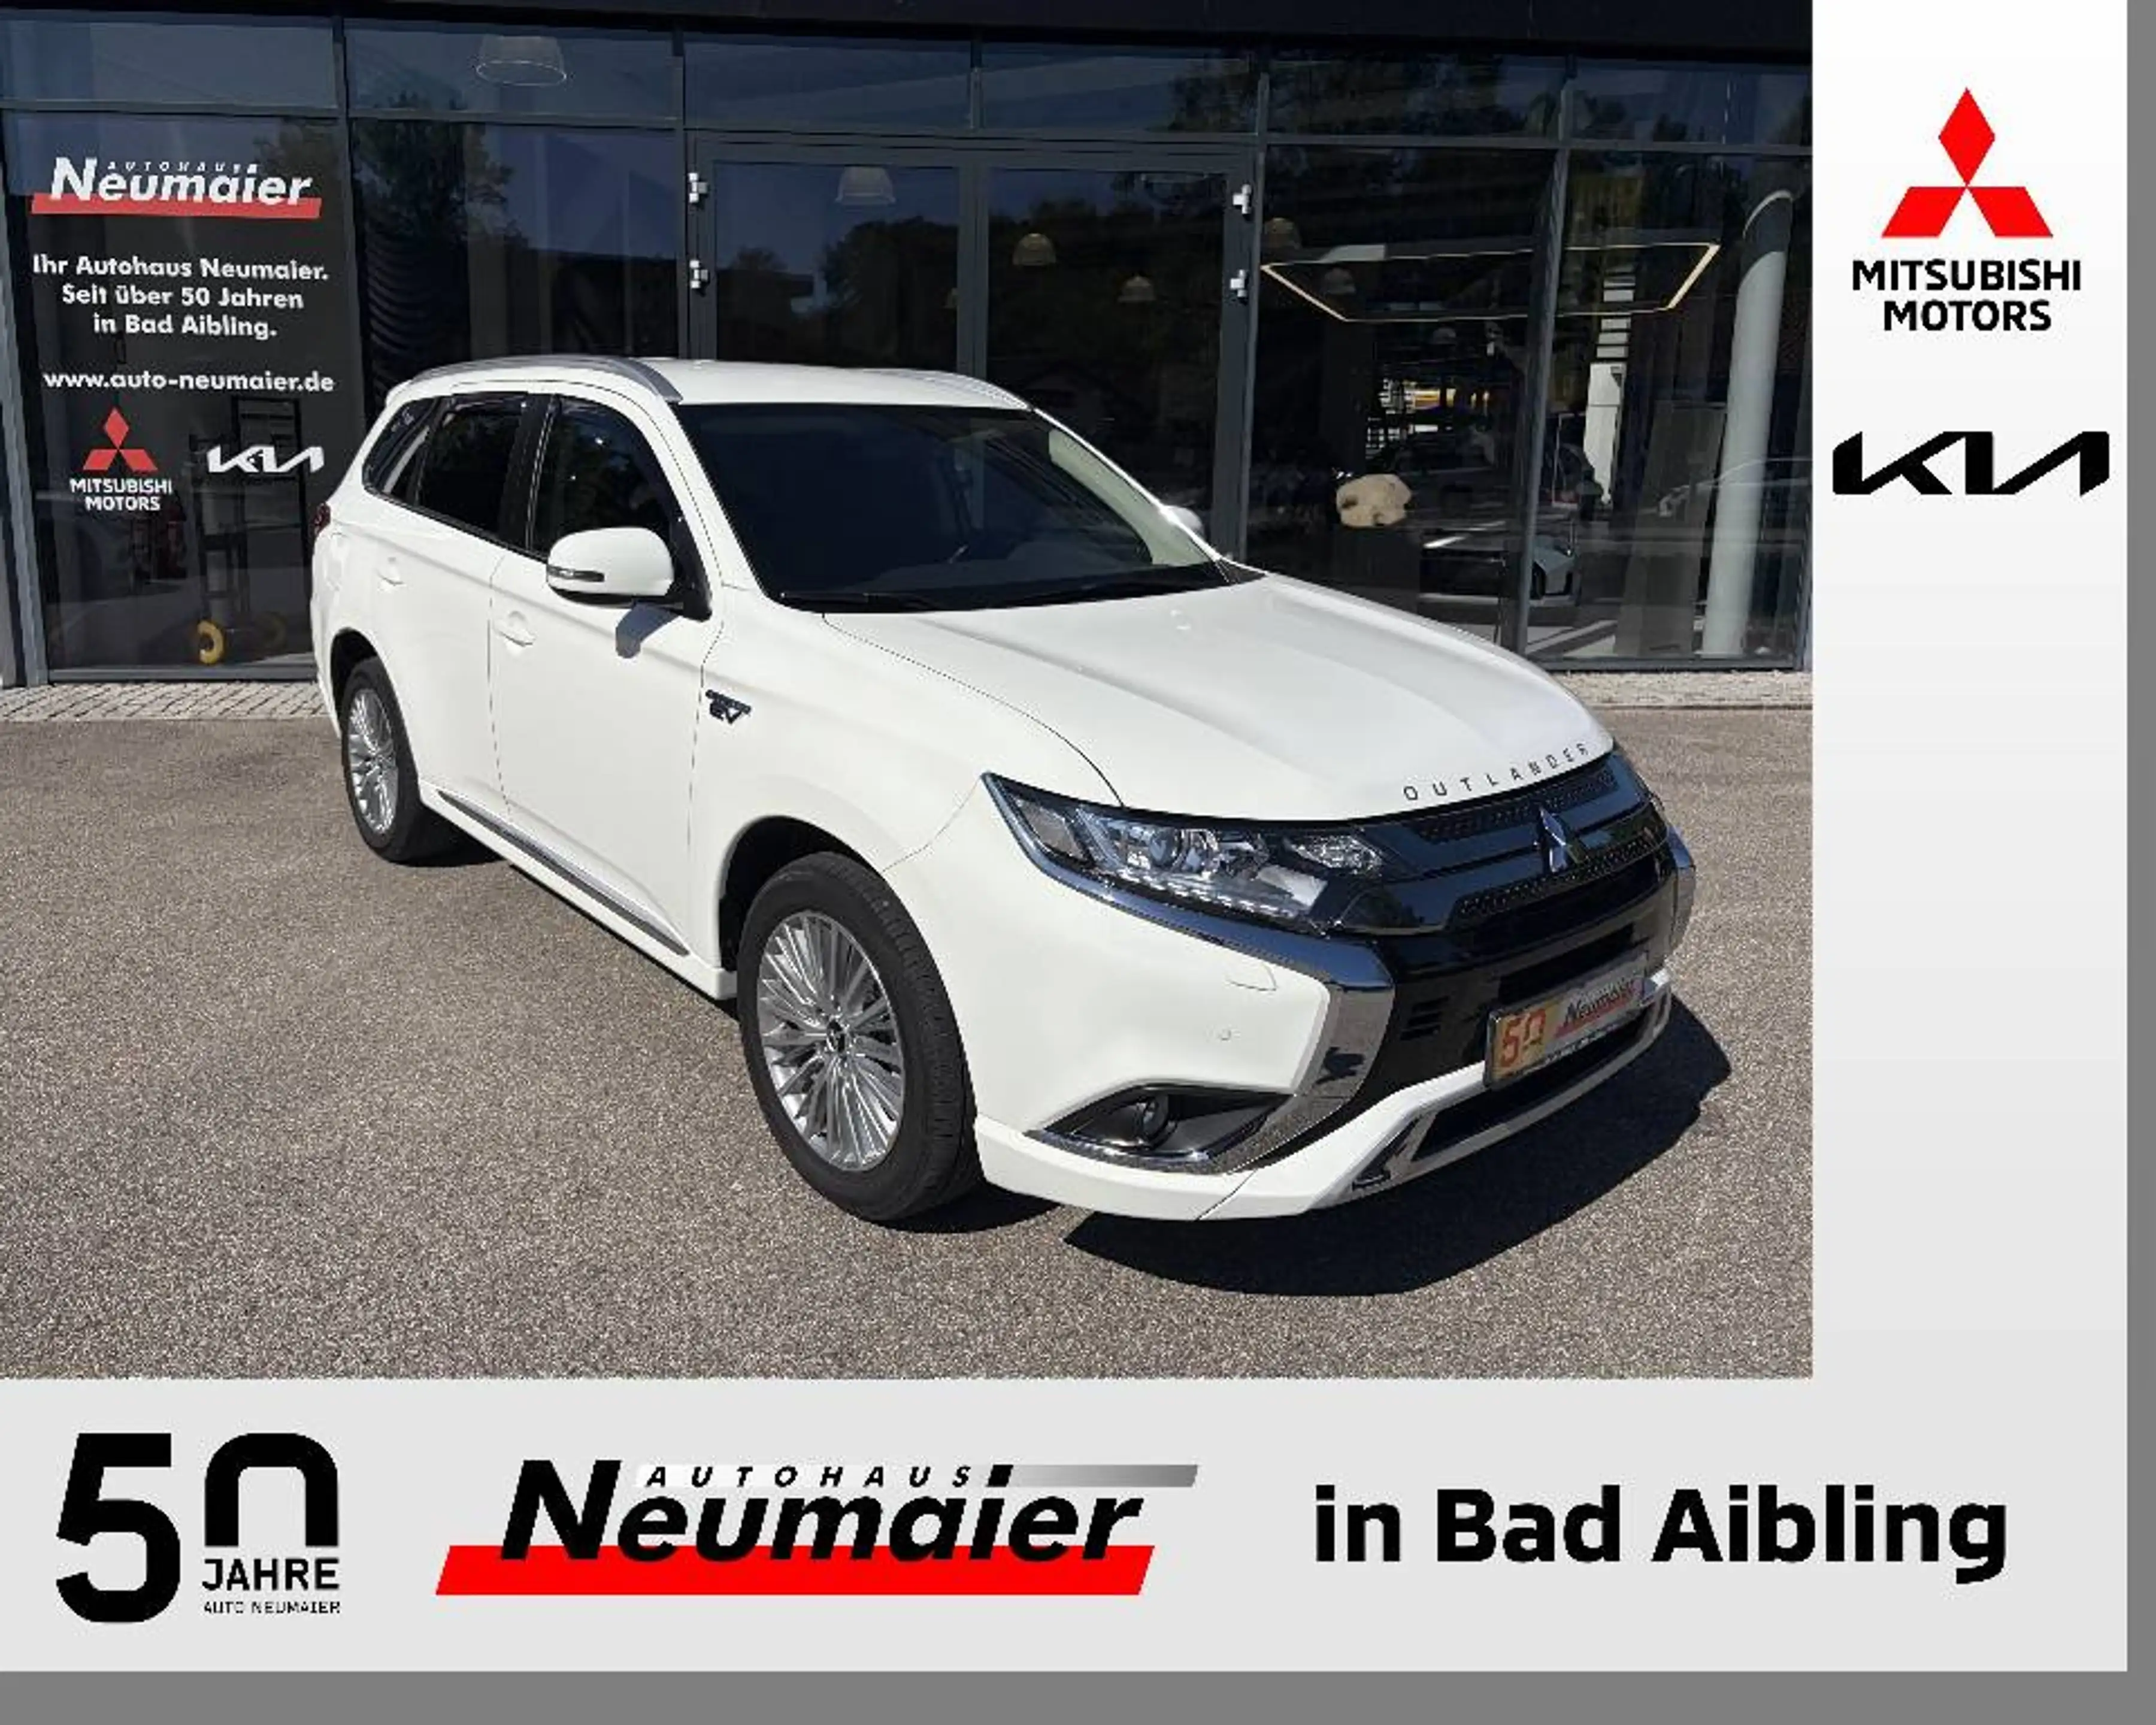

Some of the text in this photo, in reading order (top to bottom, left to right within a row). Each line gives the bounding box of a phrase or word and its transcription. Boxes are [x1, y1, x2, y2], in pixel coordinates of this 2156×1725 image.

[50, 156, 312, 205] Neumaier
[33, 254, 329, 280] Ihr Autohaus Neumaier.
[62, 285, 304, 309] Seit über 50 Jahren
[94, 313, 277, 340] in Bad Aibling.
[43, 371, 334, 392] www.auto-neumaier.de
[69, 478, 172, 494] MITSUBISHI
[85, 496, 161, 511] MOTORS
[1403, 742, 1589, 801] OUTLANDER
